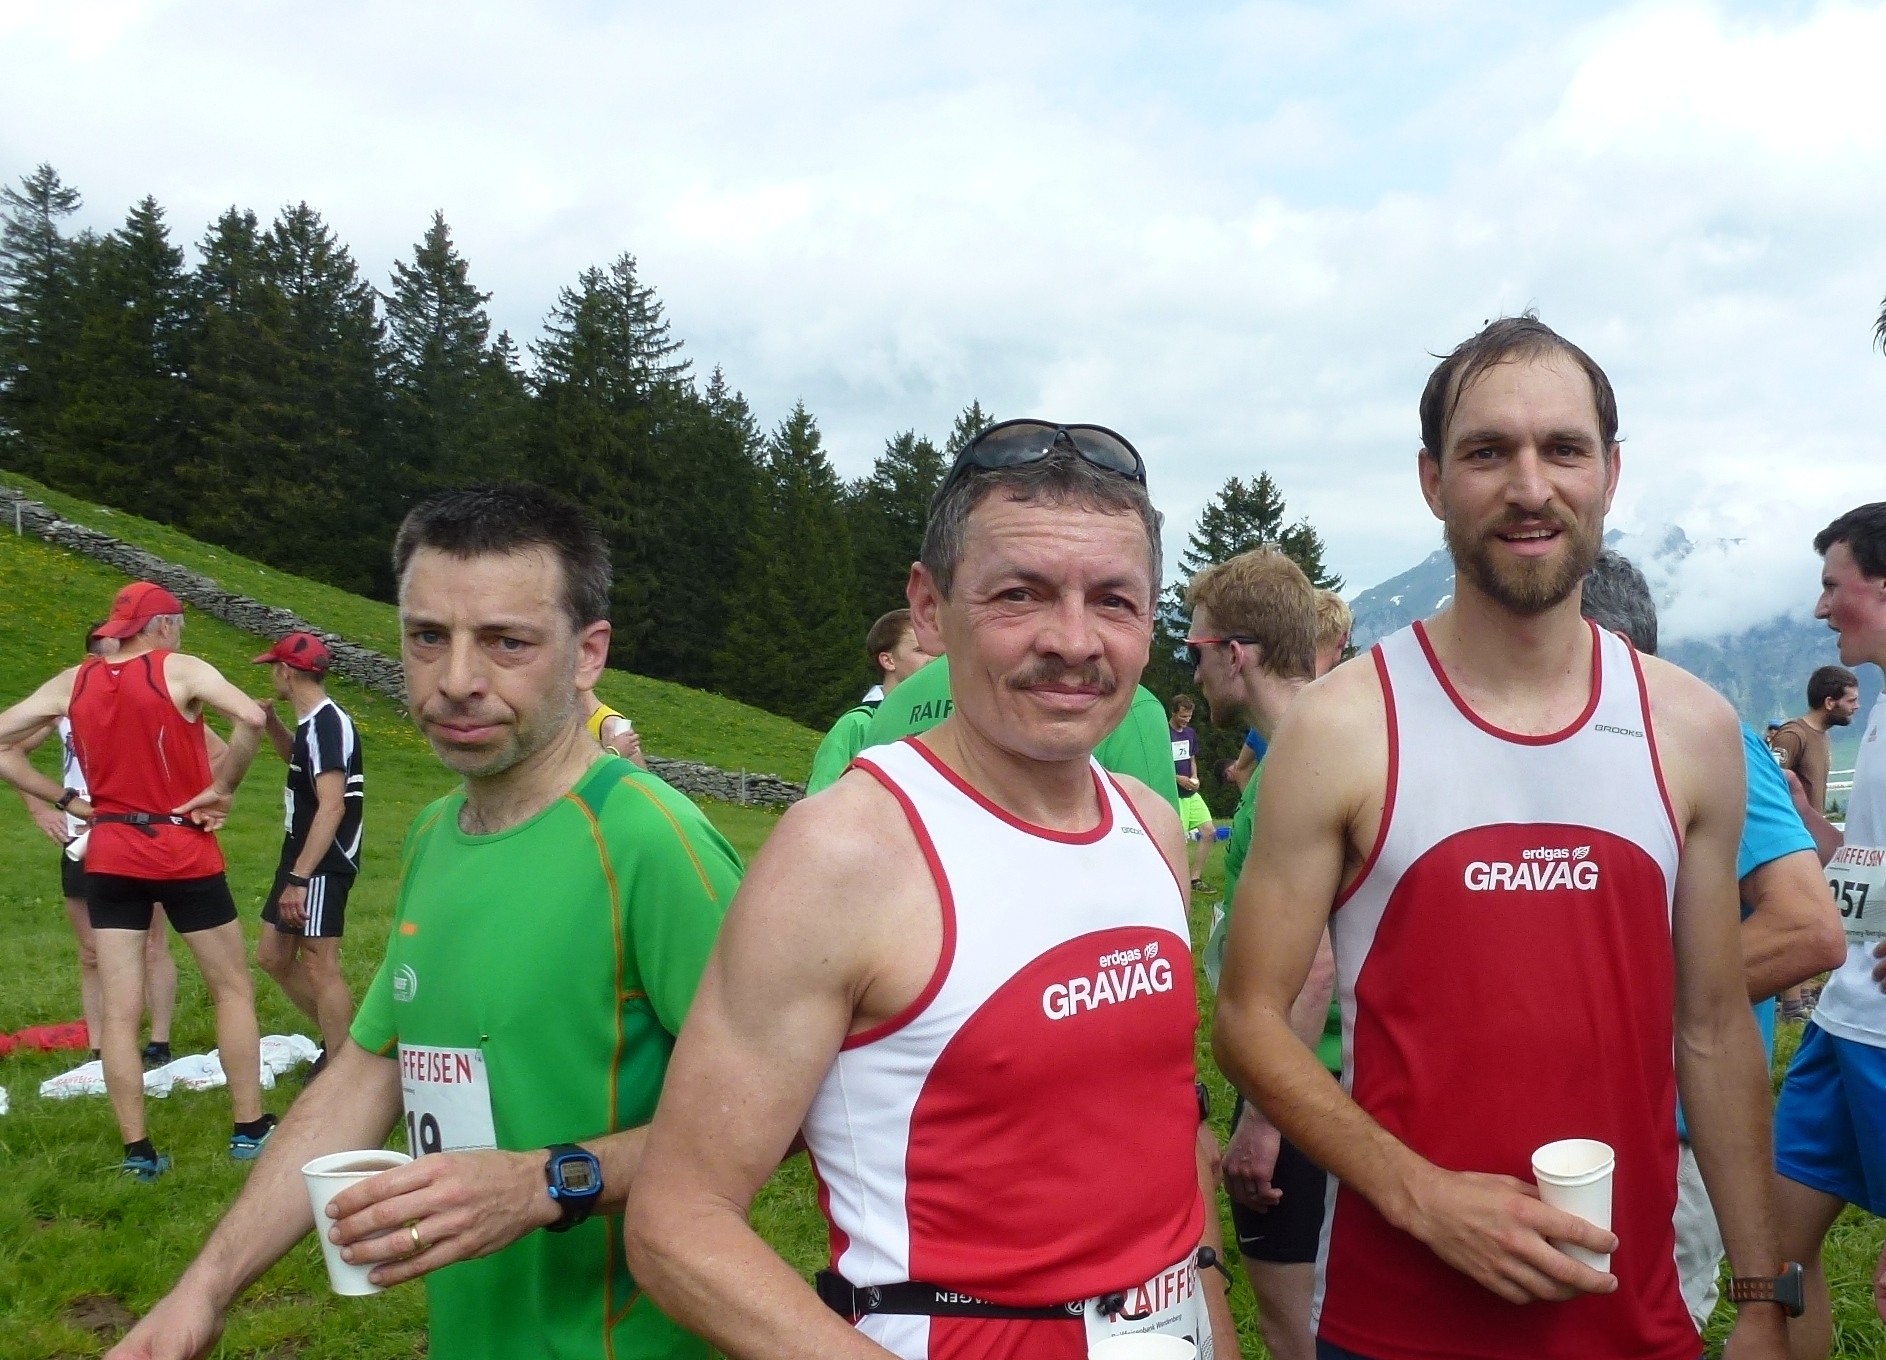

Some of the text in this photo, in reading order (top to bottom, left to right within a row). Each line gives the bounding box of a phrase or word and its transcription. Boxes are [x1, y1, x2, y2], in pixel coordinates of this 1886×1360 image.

[1594, 724, 1644, 738] BROOKS
[1522, 847, 1570, 861] erdgas
[1464, 861, 1599, 891] GRAVAG
[1099, 947, 1142, 967] erdgas
[1042, 958, 1173, 1020] GRAVAG
